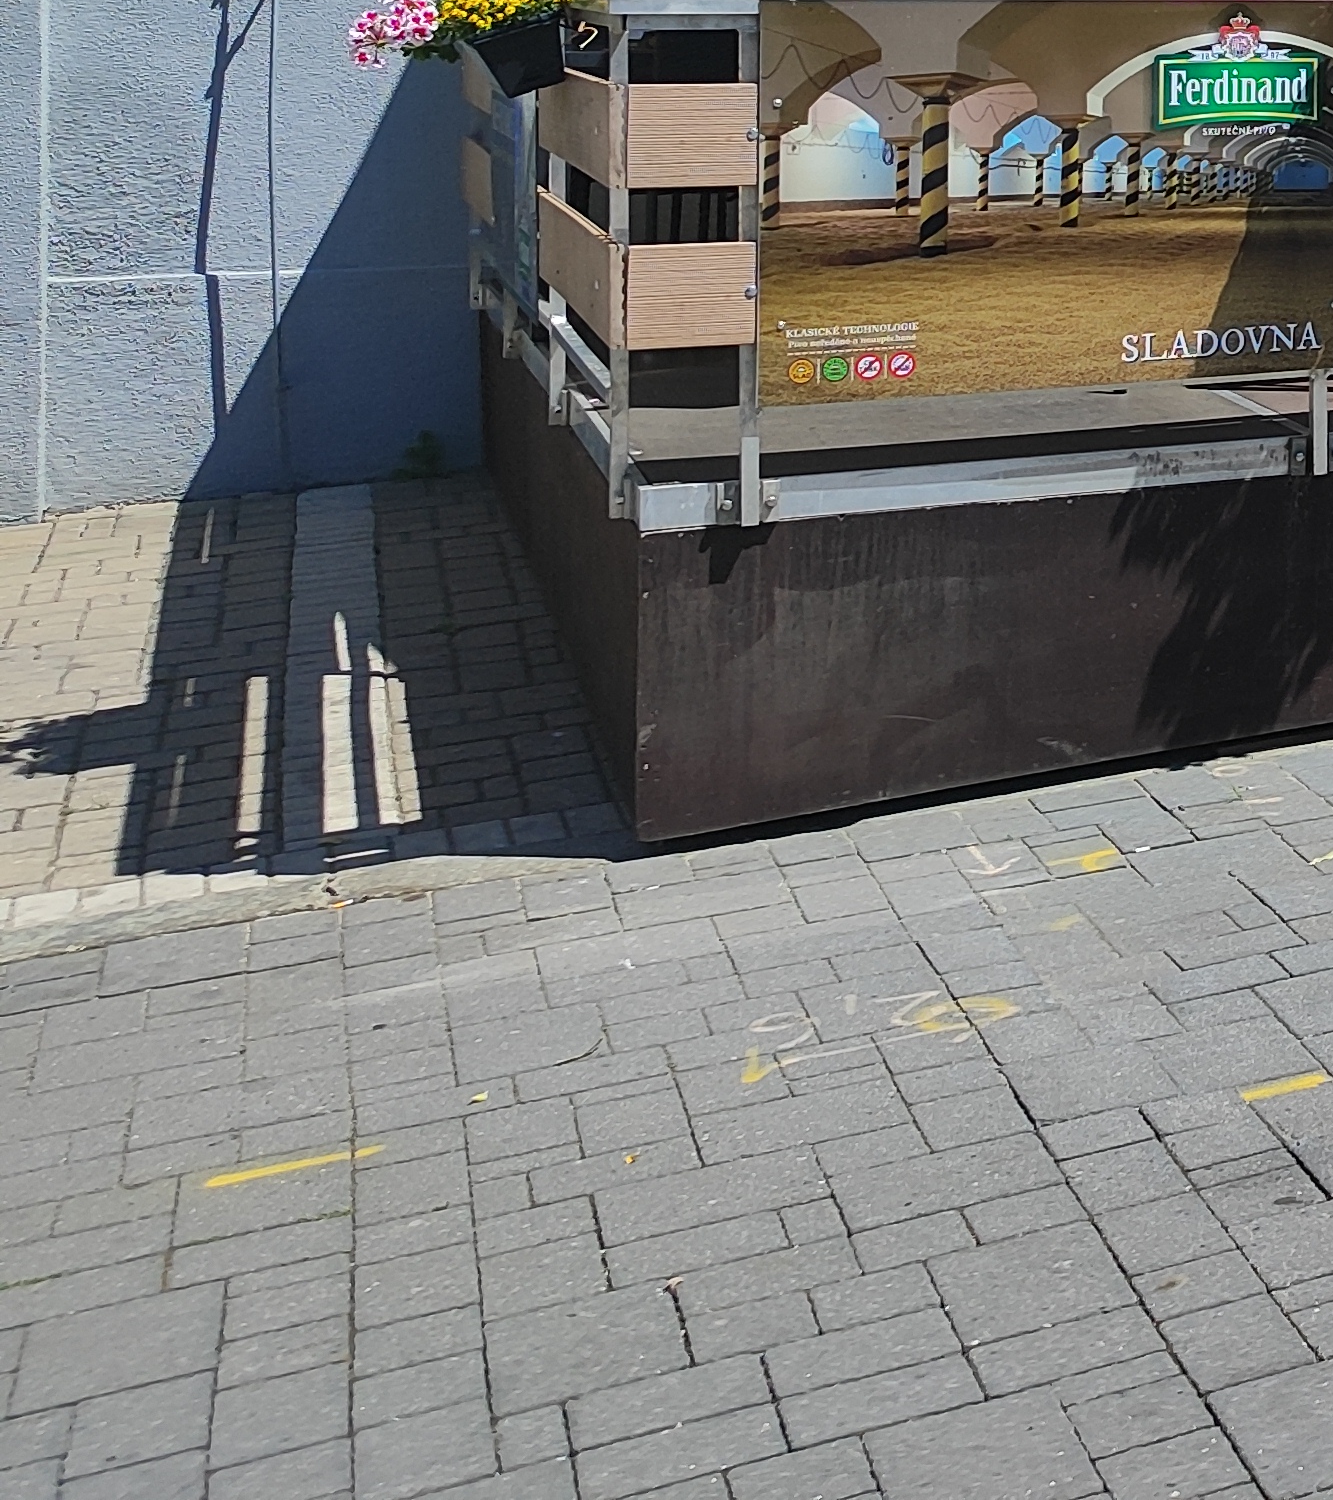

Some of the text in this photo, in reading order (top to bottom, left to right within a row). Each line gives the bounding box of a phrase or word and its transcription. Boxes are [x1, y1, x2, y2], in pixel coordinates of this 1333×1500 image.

[1168, 68, 1308, 106] Ferdinand
[785, 321, 920, 339] KLASICKÉ TECHNOLOGIE
[1120, 321, 1323, 363] SLADOVNA
